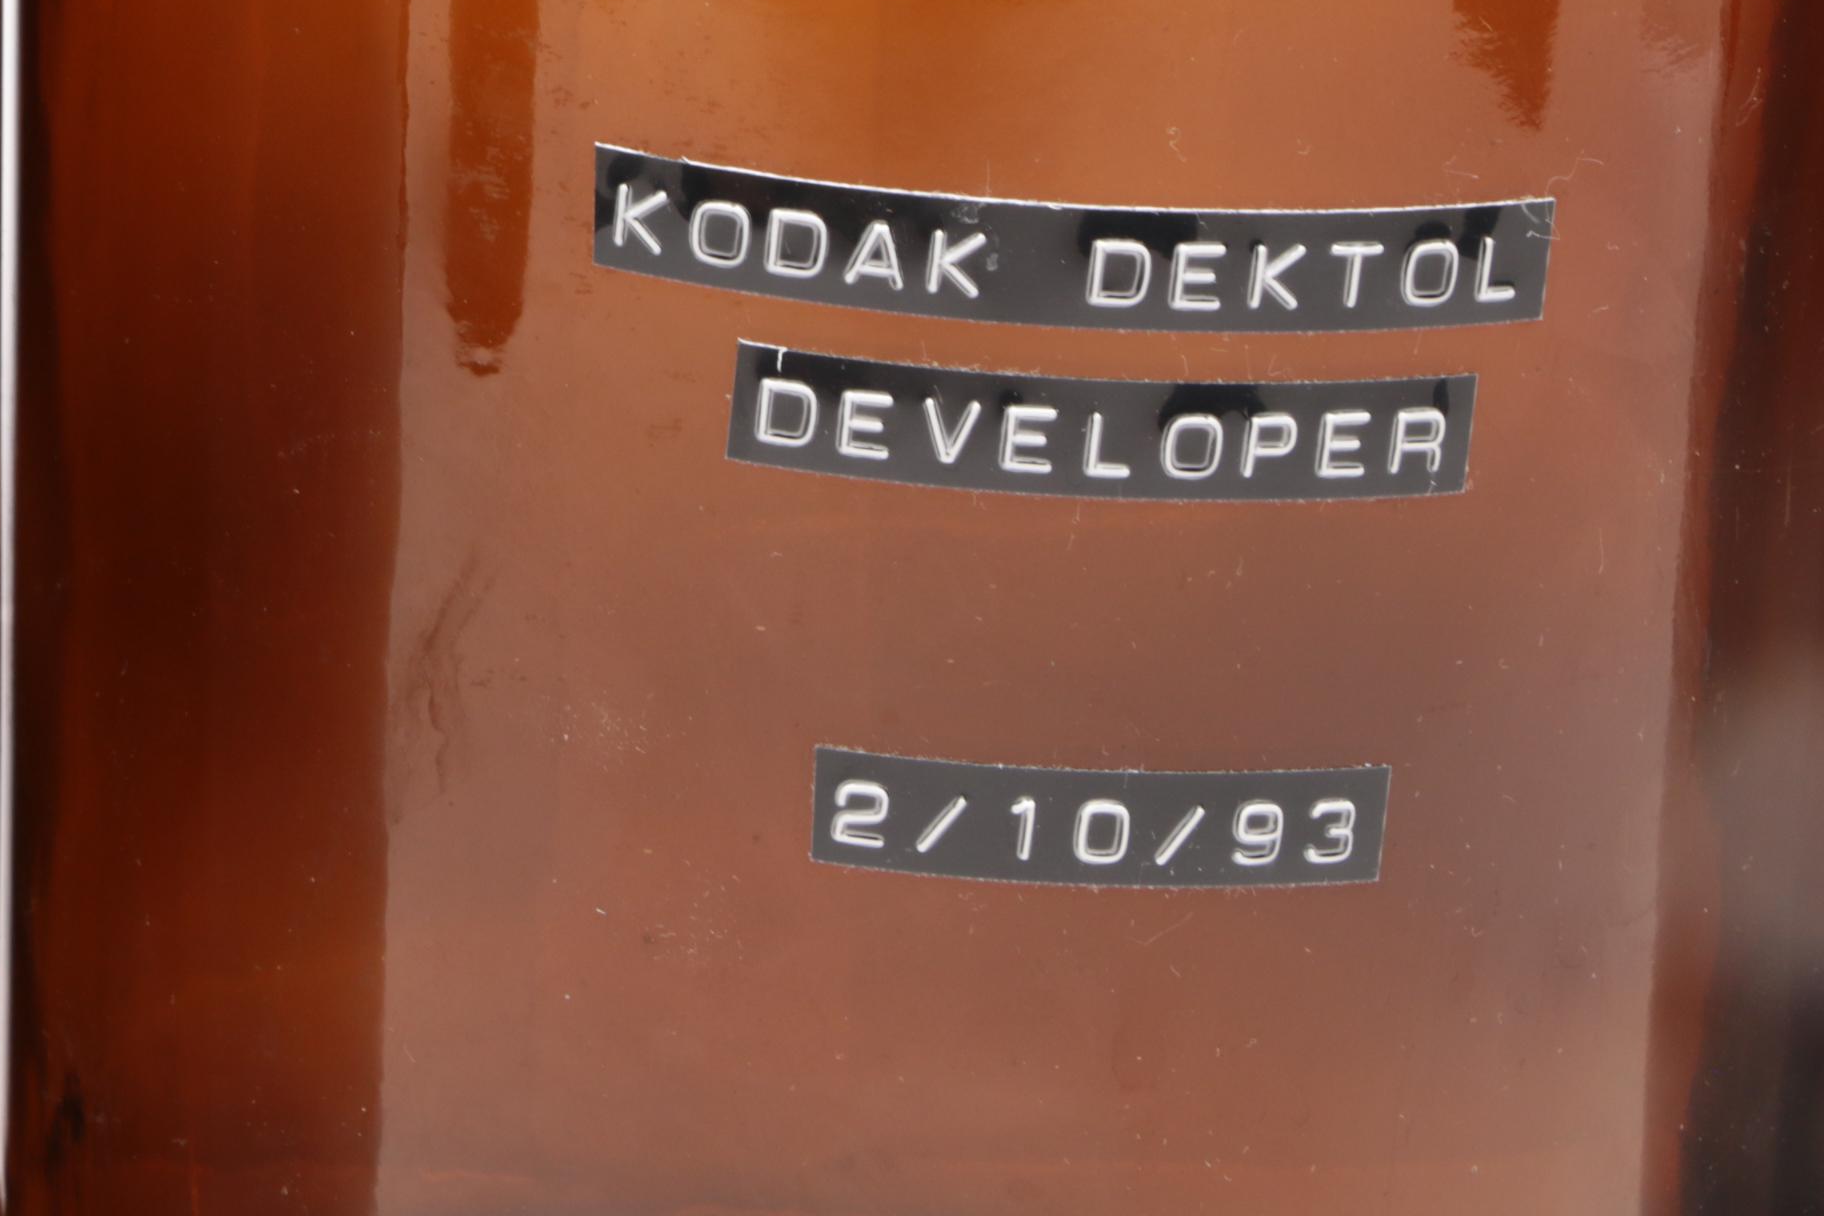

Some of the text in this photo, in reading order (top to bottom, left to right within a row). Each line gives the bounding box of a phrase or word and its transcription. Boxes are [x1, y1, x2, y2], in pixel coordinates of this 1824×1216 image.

[612, 182, 1518, 312] KODAK DEKTOL
[753, 376, 1449, 481] DEVELOPER
[828, 778, 1359, 867] 2/10/93
